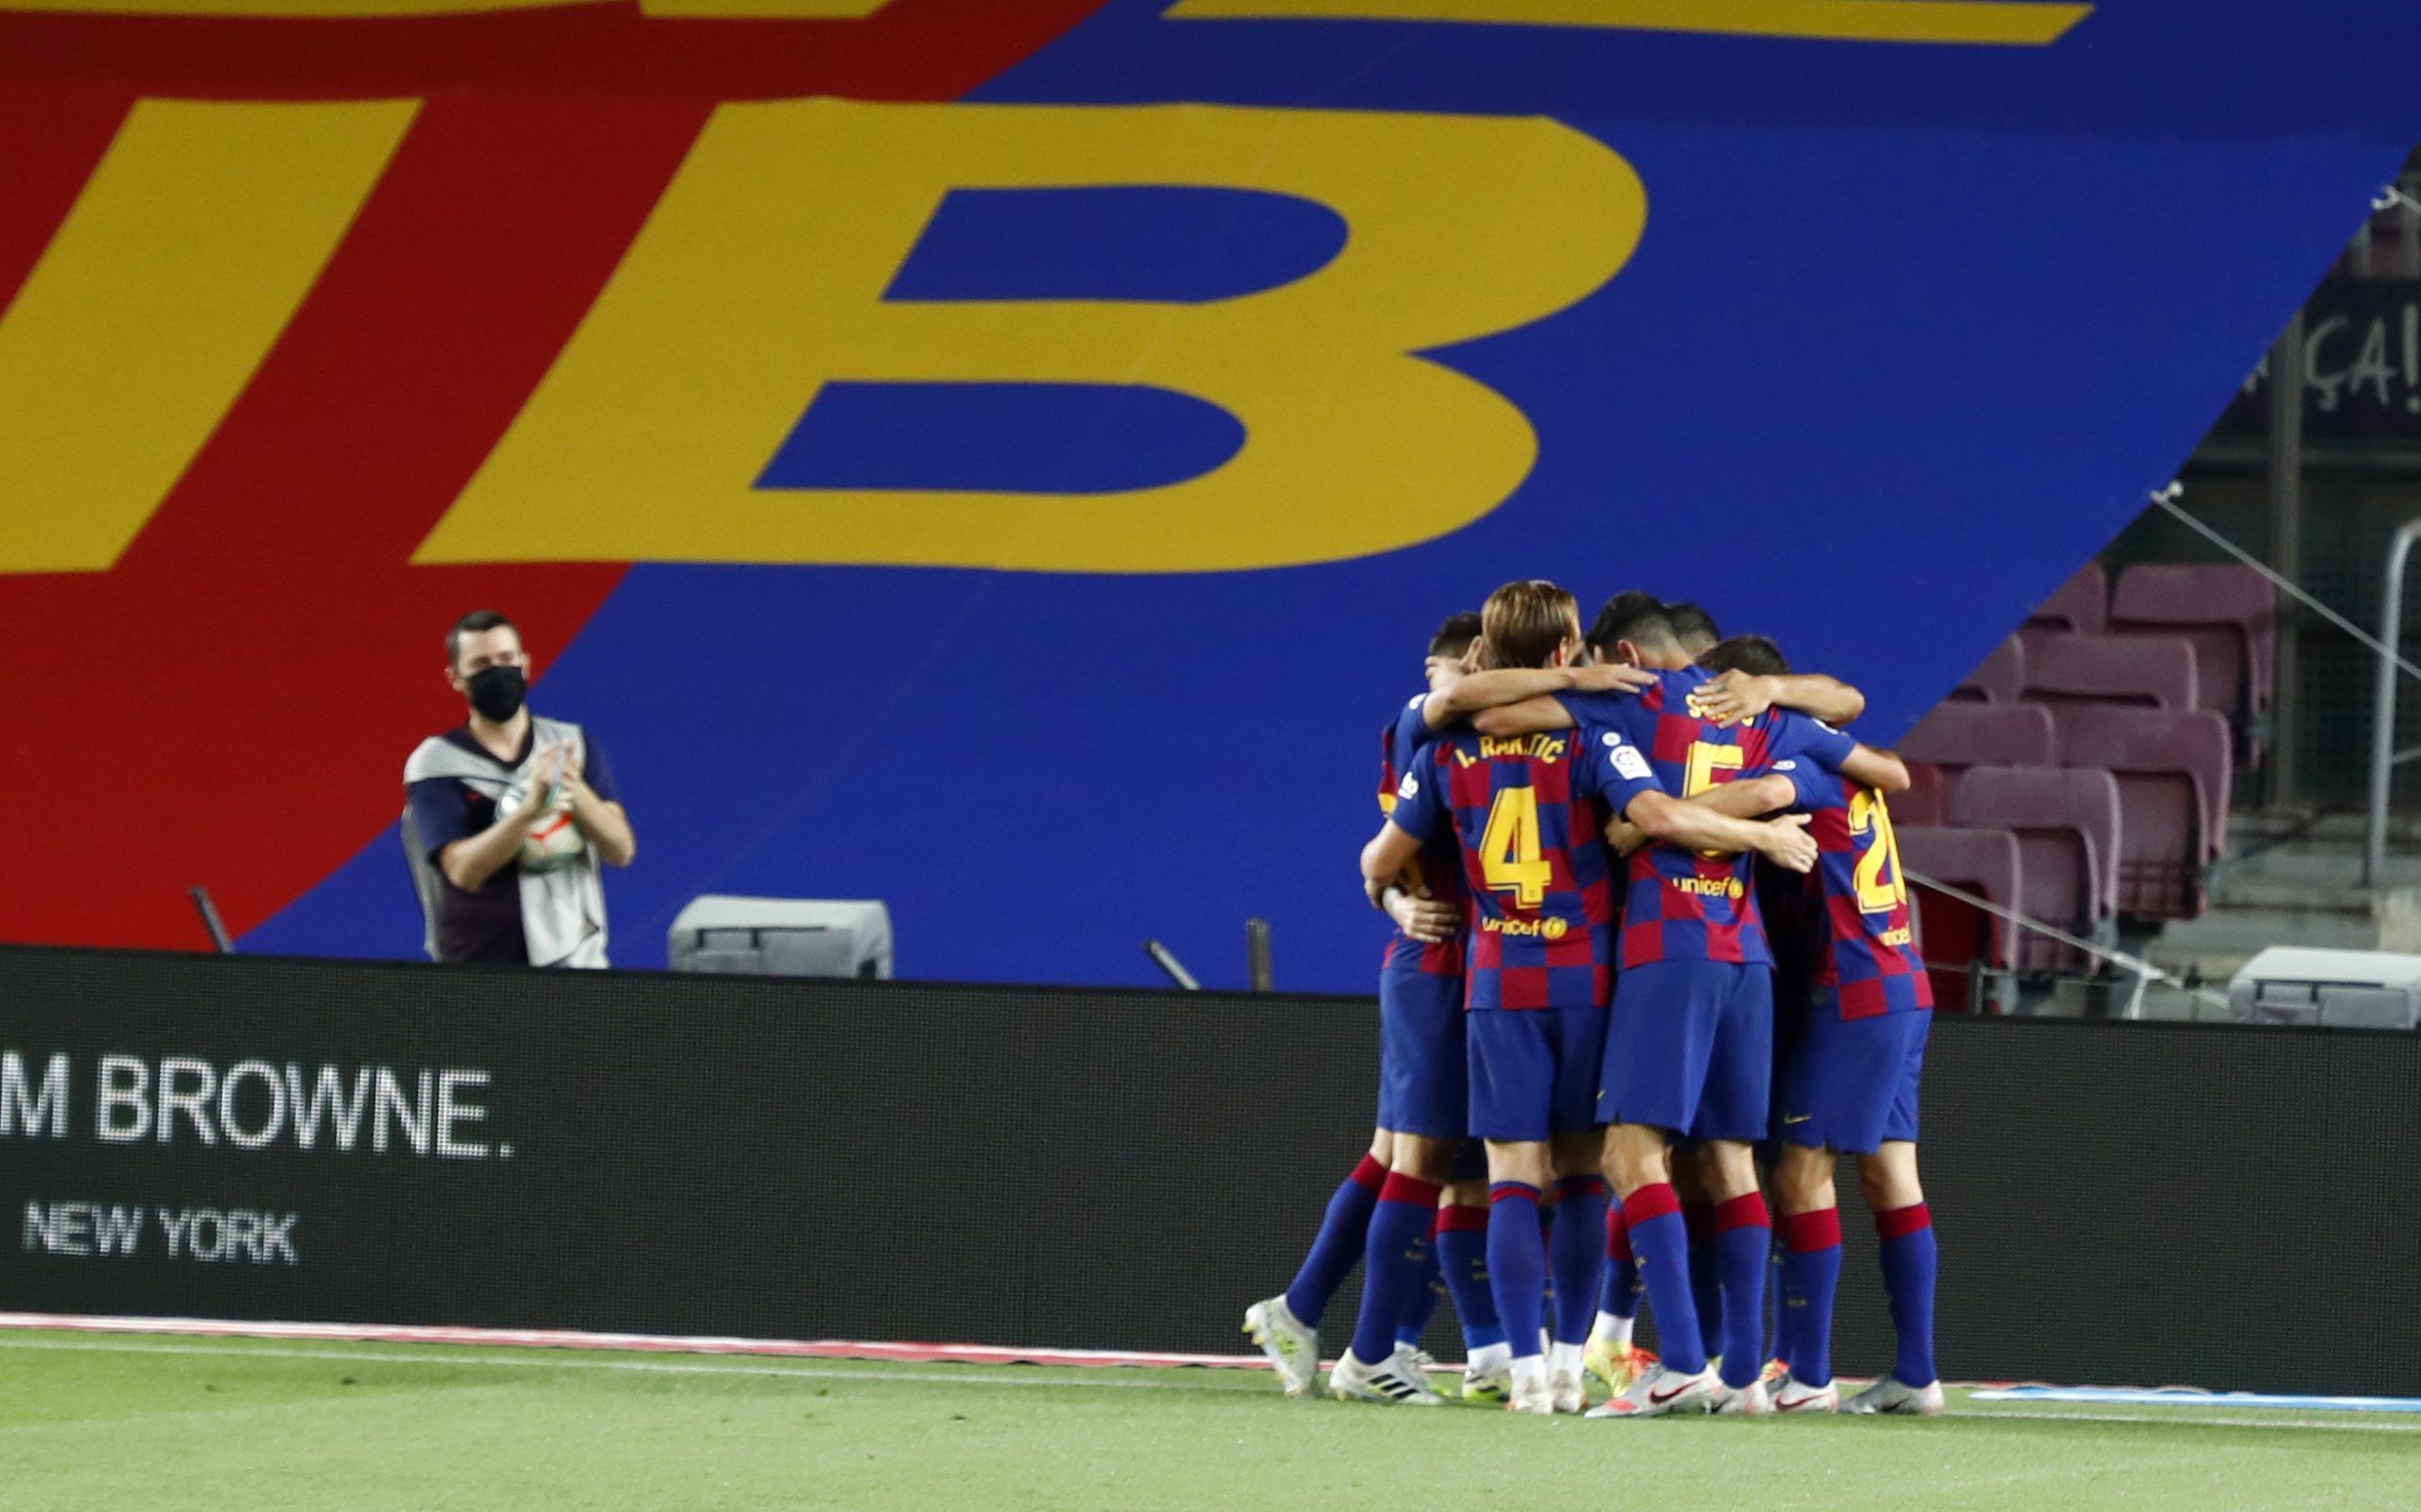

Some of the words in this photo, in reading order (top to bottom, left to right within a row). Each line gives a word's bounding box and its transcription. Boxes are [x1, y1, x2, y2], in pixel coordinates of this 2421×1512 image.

[1478, 785, 1552, 910] 4
[1672, 874, 1729, 897] unicef
[1482, 915, 1541, 937] unicef
[97, 1053, 514, 1159] BROWNE.
[22, 1199, 143, 1258] NEW
[159, 1208, 300, 1265] YORK
